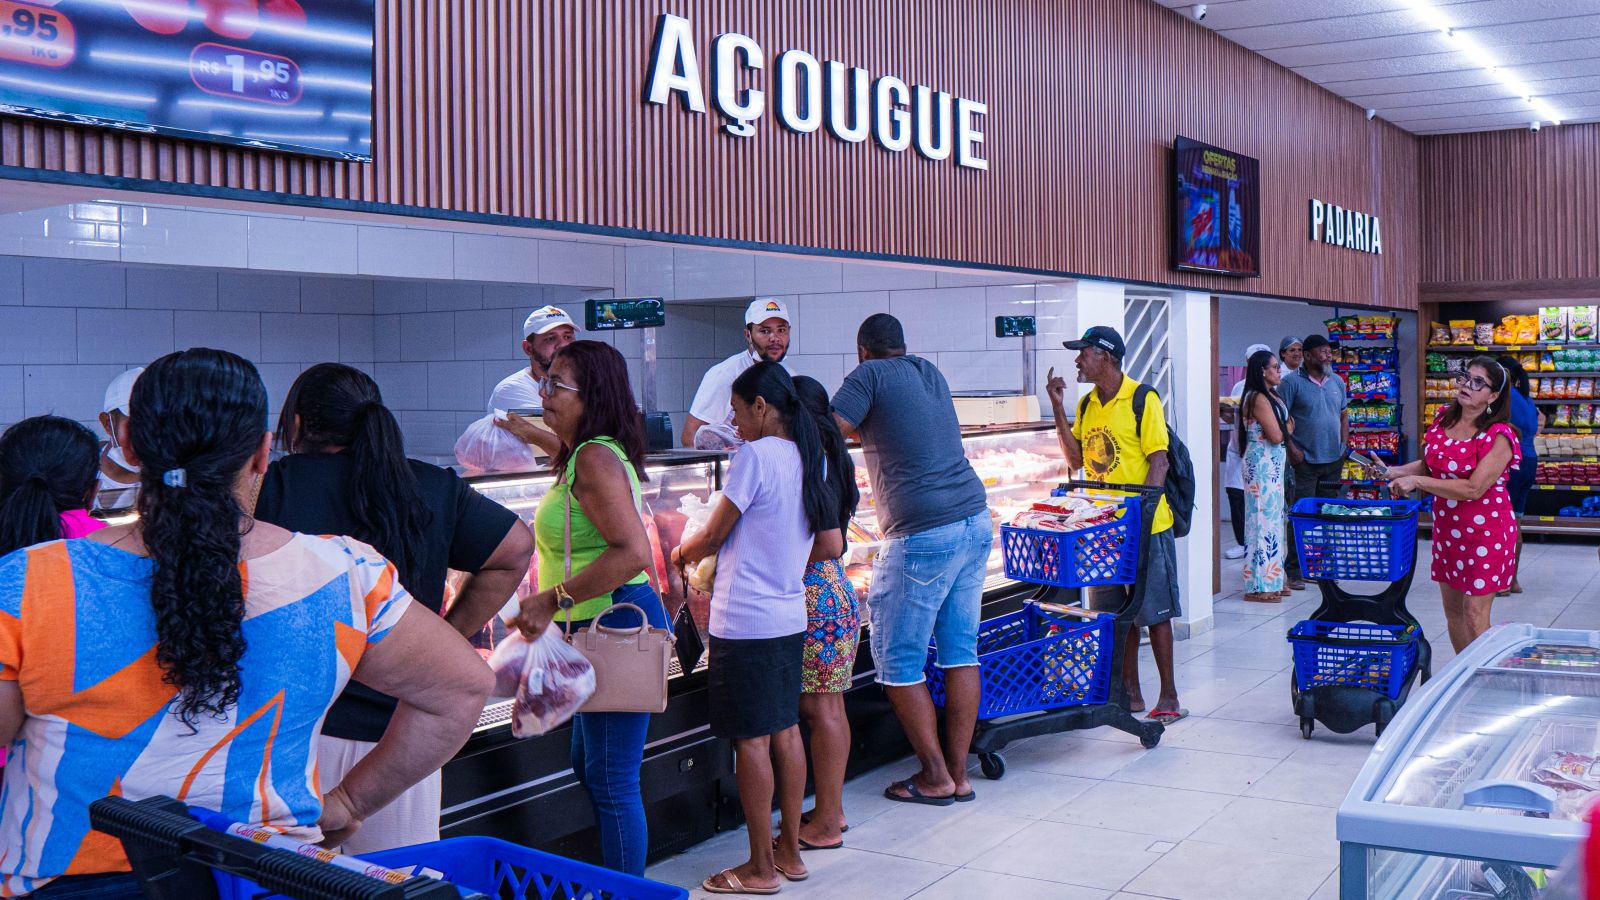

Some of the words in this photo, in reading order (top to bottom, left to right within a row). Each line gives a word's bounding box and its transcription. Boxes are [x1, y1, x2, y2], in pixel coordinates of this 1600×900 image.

[31, 46, 58, 60] 1KG
[199, 60, 219, 75] R$
[270, 88, 289, 100] 1KG
[644, 13, 988, 171] AÇOUGUE
[1203, 150, 1236, 171] OFERTAS
[1309, 198, 1382, 254] PADARIA
